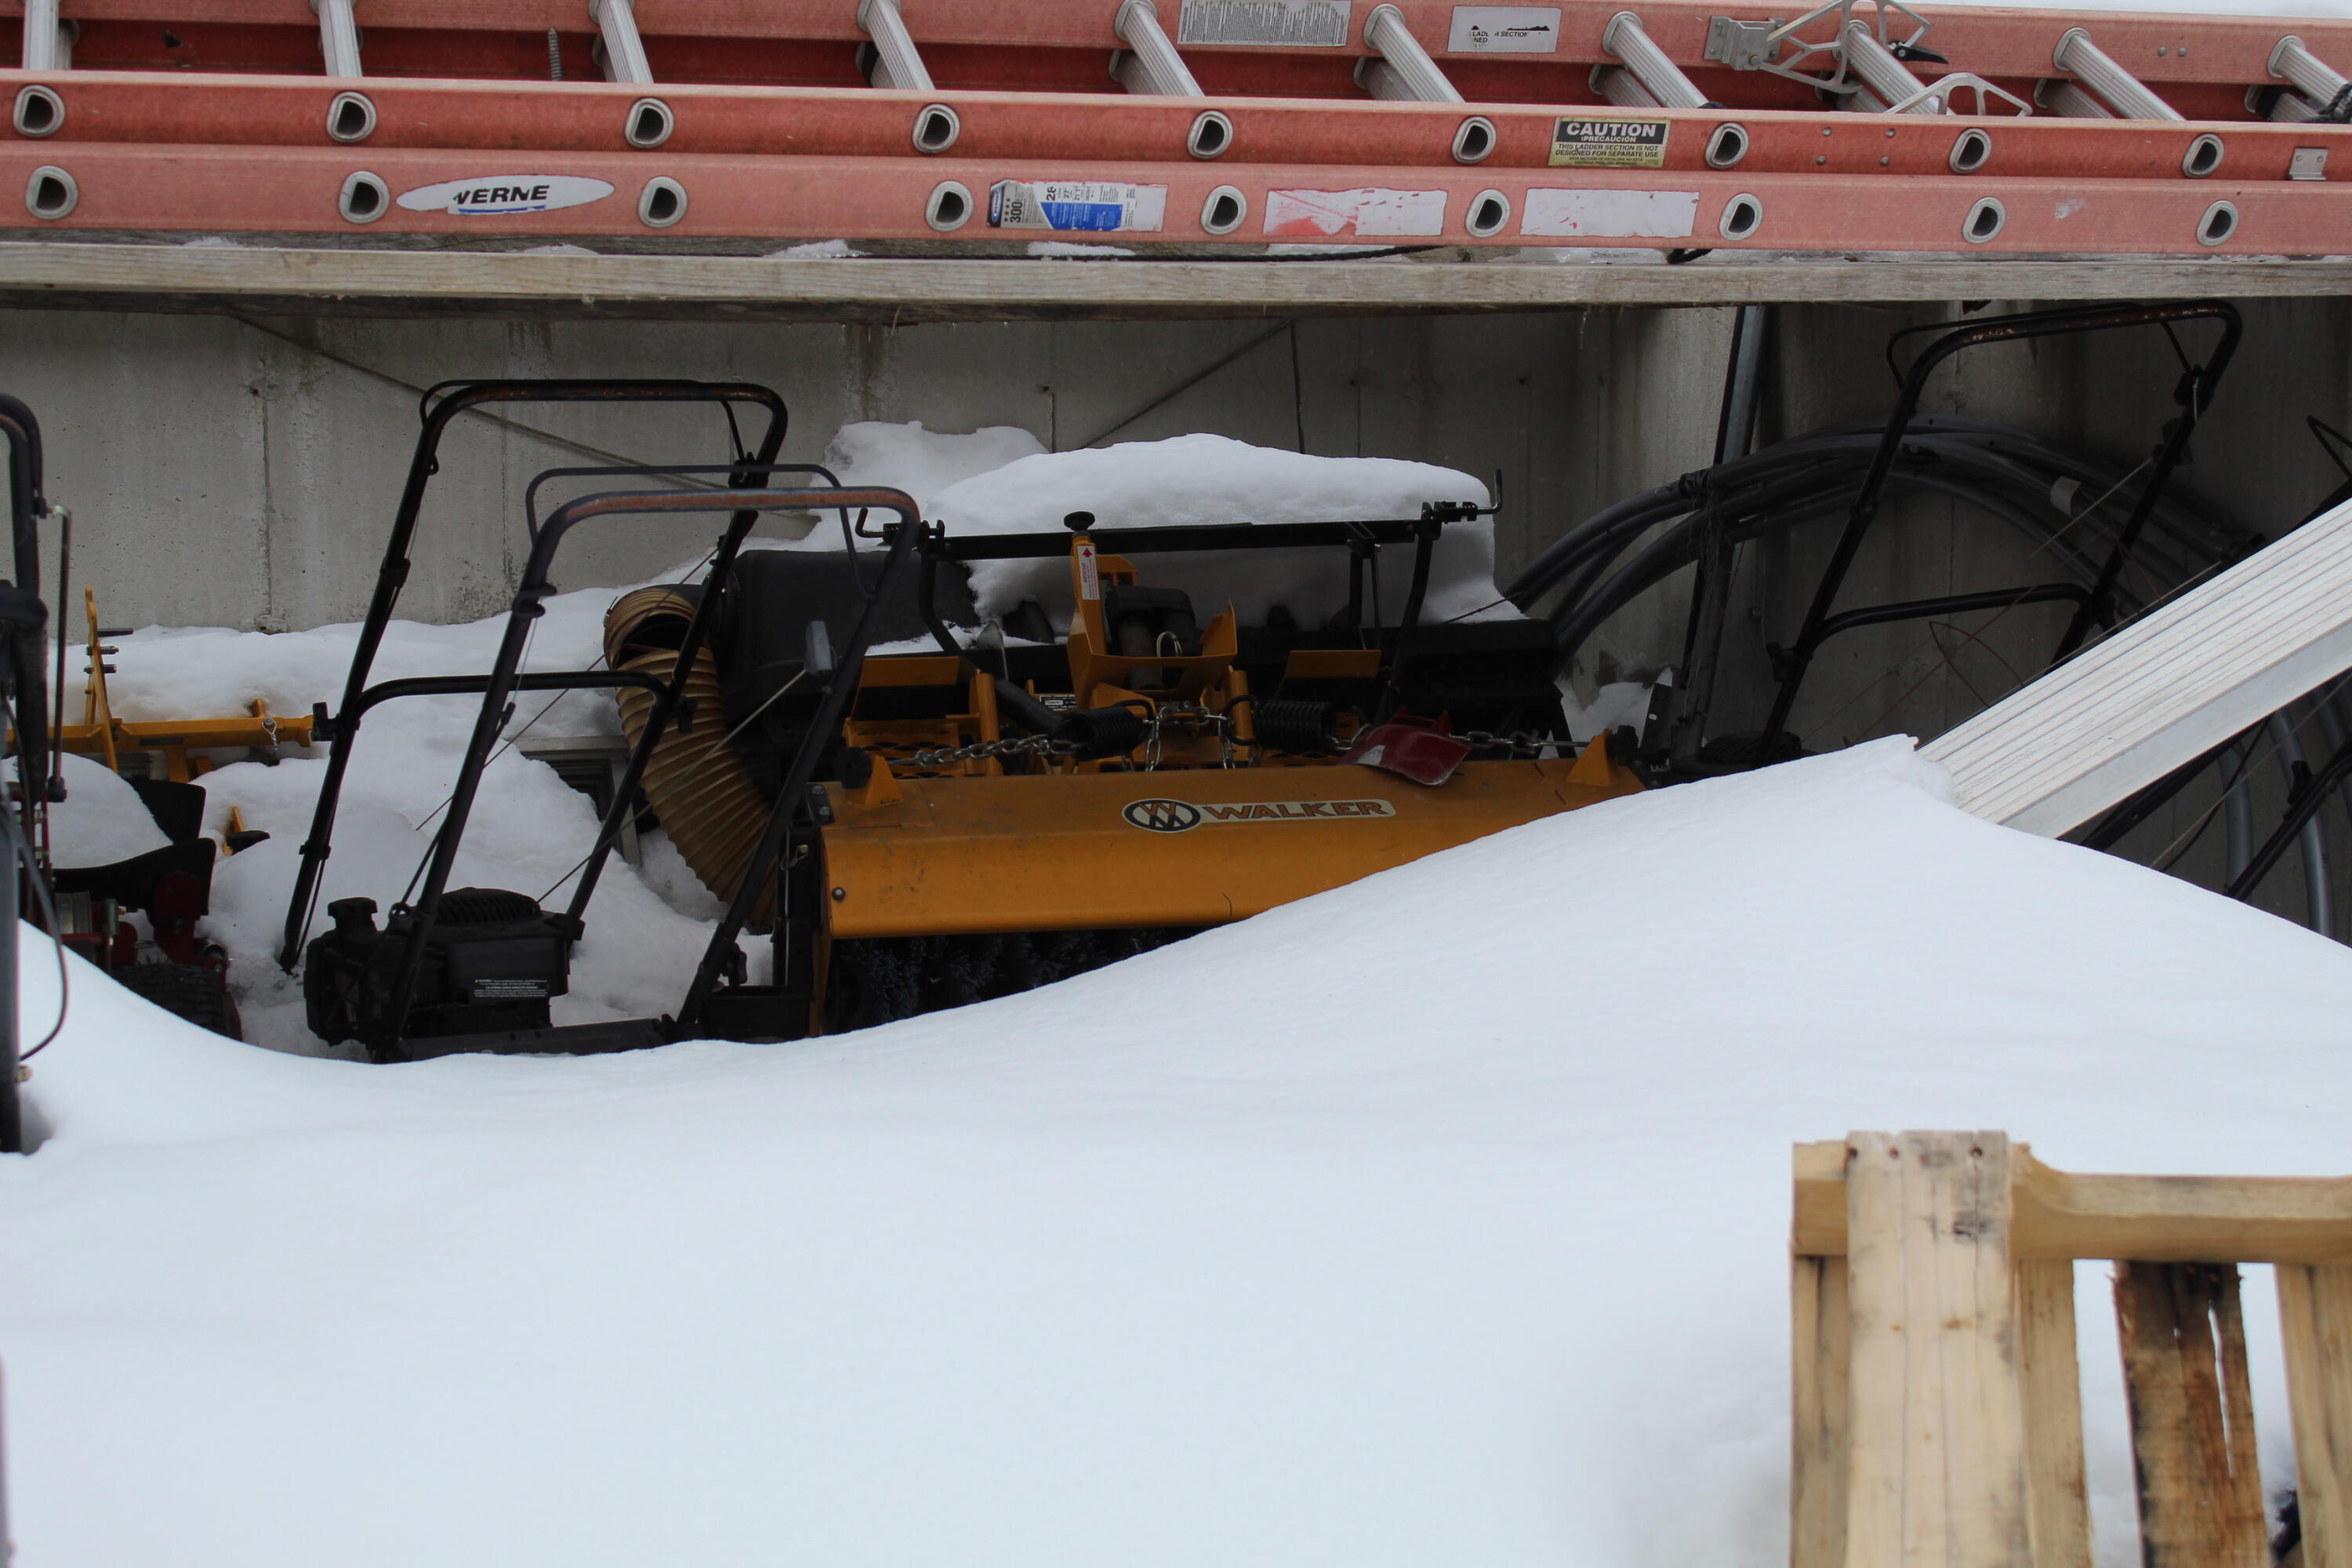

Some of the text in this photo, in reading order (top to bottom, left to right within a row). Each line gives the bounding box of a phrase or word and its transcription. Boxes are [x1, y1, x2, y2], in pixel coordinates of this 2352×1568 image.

[1566, 122, 1657, 137] CAUTION
[1009, 201, 1023, 223] 300
[1203, 801, 1389, 820] WALKER
